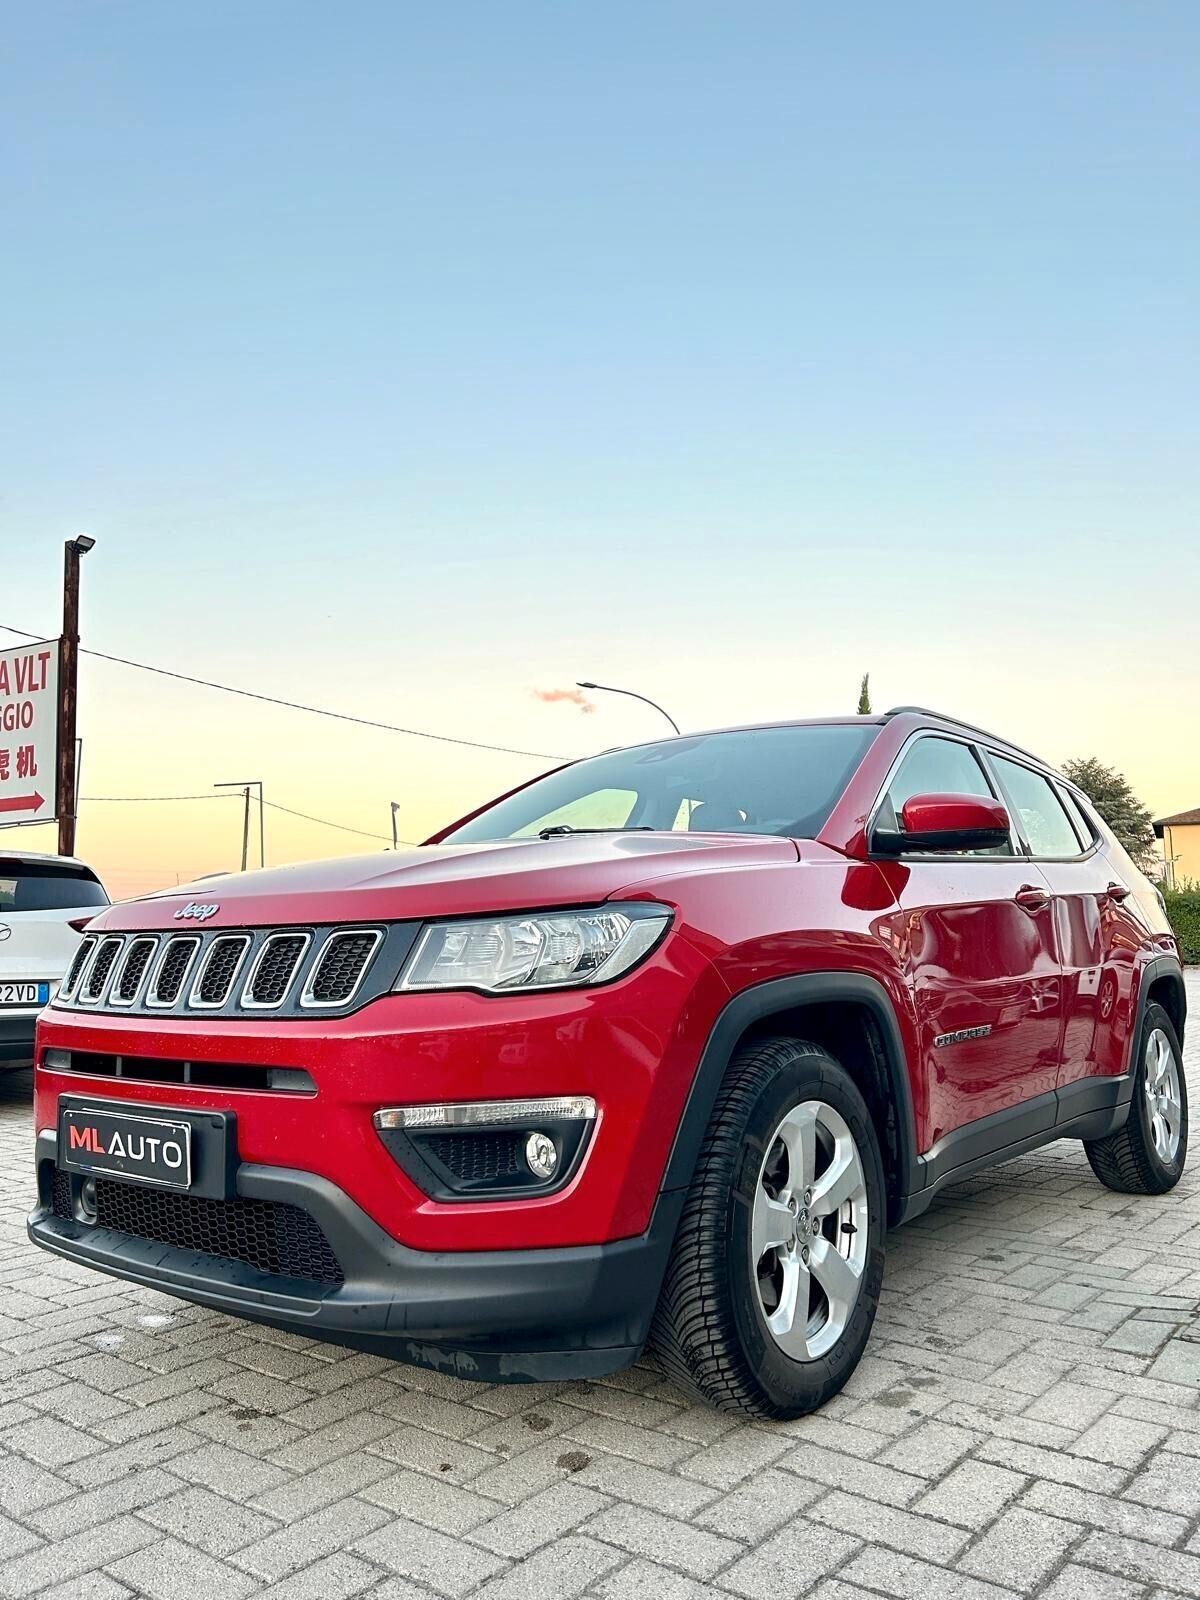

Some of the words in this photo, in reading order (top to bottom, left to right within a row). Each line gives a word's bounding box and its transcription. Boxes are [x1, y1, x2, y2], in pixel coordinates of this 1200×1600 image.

[14, 651, 51, 694] VLT
[0, 700, 34, 732] GIO
[173, 901, 220, 922] Jeep
[0, 985, 36, 1002] 2VD
[69, 1125, 106, 1155] ML
[107, 1130, 183, 1169] AUTO
